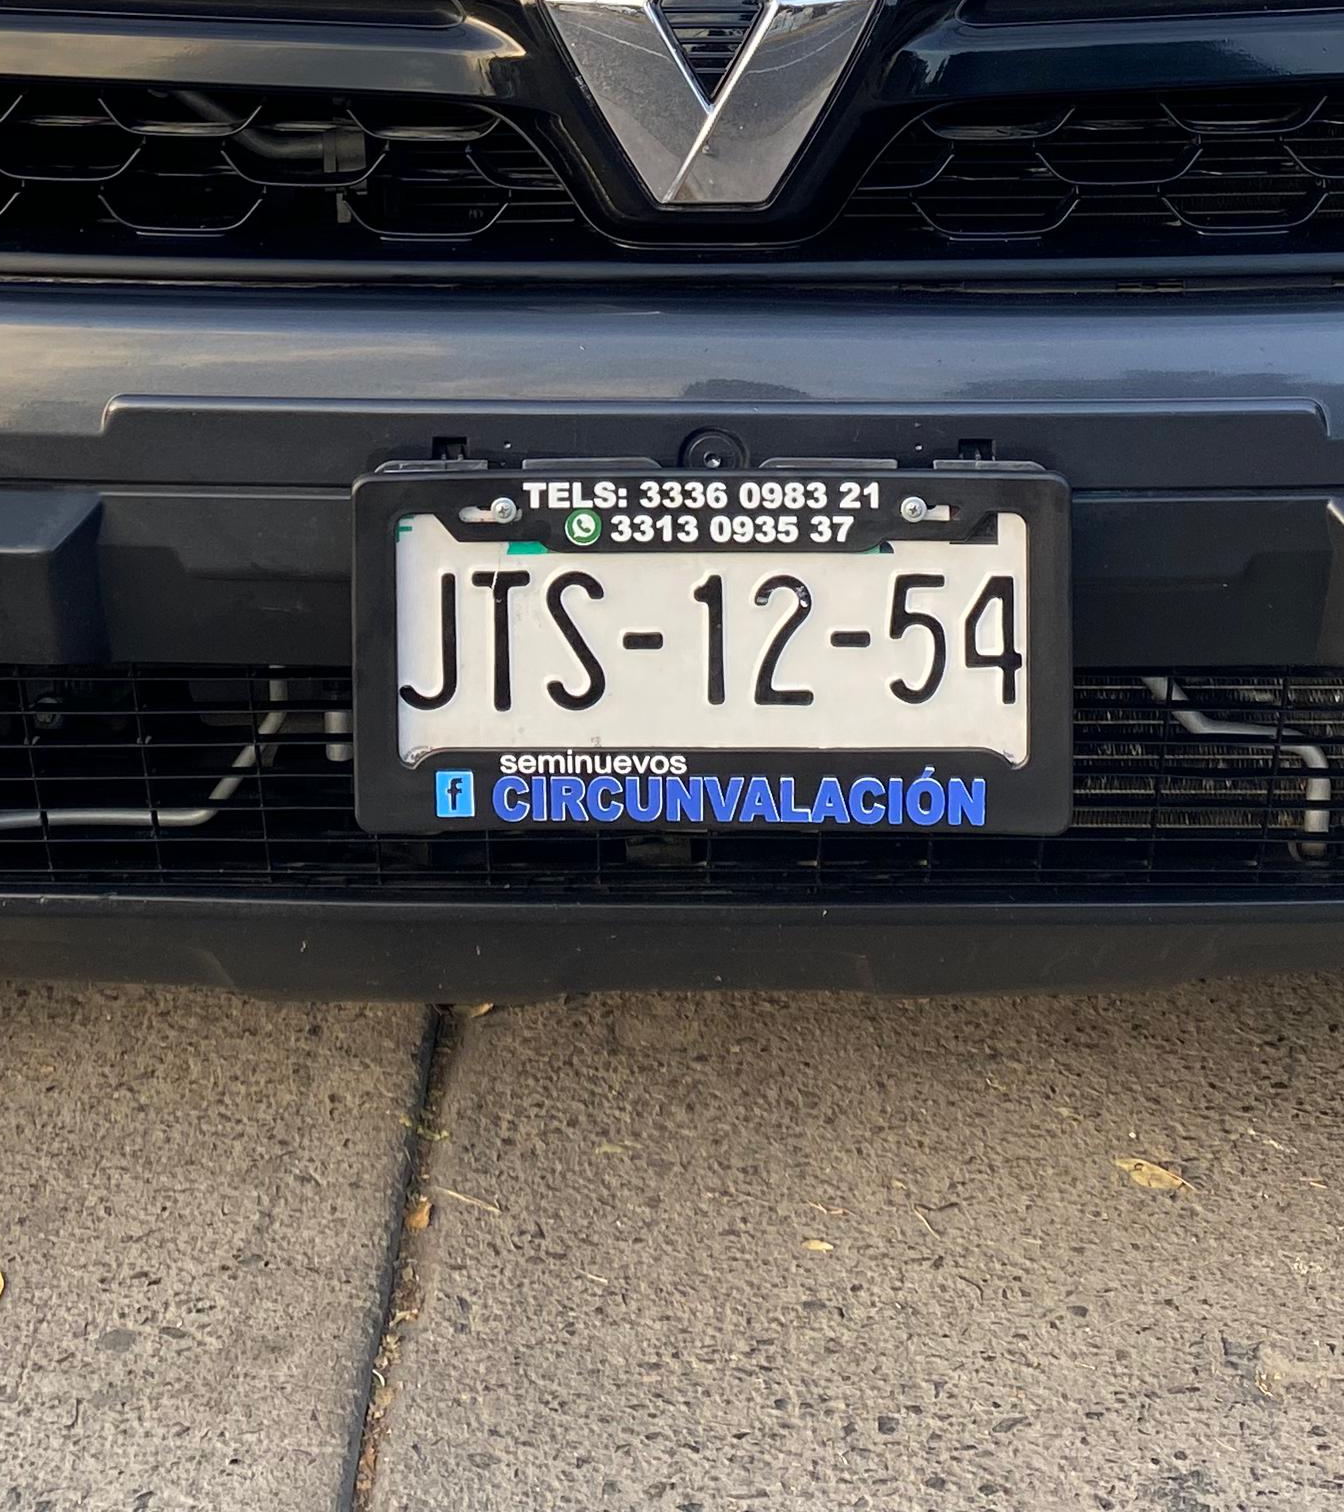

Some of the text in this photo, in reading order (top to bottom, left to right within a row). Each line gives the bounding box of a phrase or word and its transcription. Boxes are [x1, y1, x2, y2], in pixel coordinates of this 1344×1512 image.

[523, 482, 879, 509] TELS: 3336 0983 21
[610, 515, 854, 543] 3313 0935 37
[399, 570, 1023, 711] JTS-12-54
[499, 750, 688, 775] seminuevos
[492, 766, 986, 826] CIRCUNVALACIÓN
